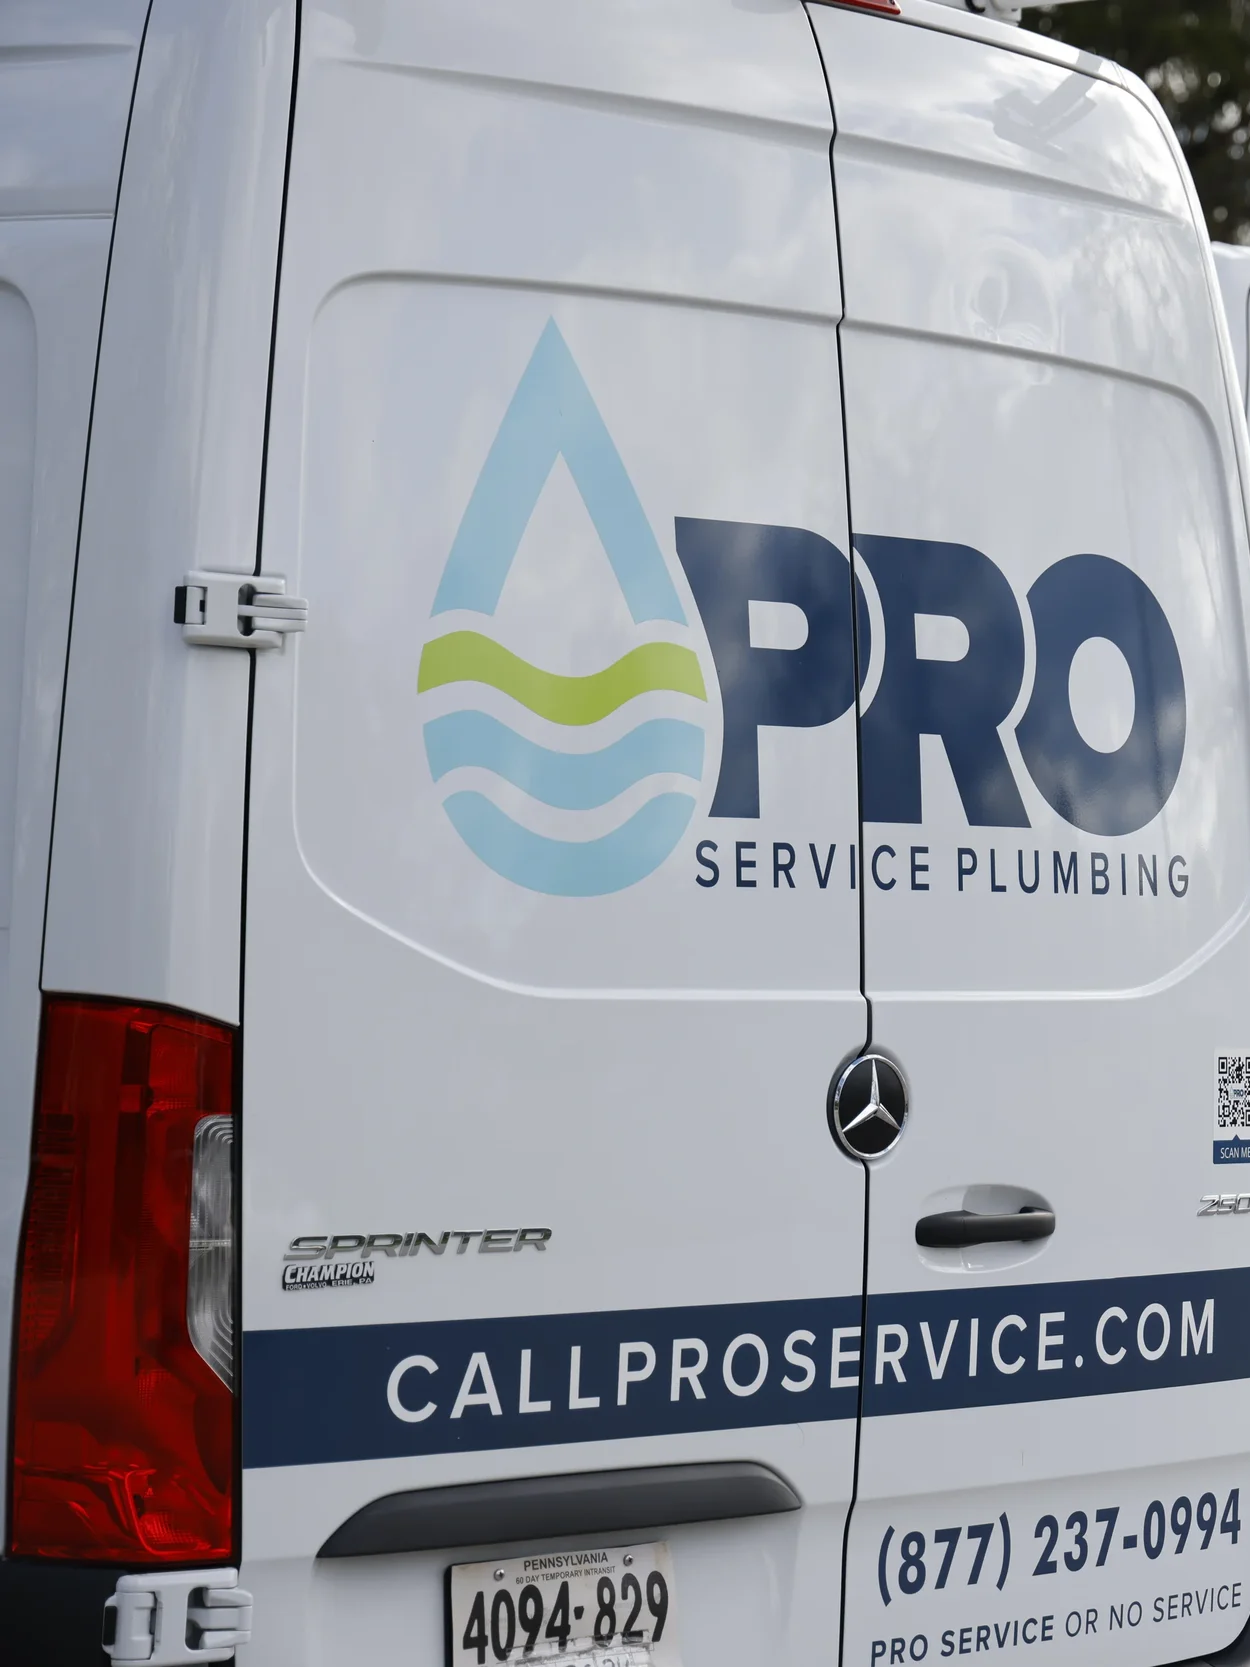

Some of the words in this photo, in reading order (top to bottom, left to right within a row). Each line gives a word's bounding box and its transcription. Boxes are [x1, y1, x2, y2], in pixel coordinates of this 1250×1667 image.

[675, 516, 1187, 837] PRO
[694, 840, 930, 893] SERVICE
[957, 847, 1191, 899] PLUMBING
[1220, 1147, 1239, 1159] SCAN
[283, 1227, 552, 1260] SPRINTER
[284, 1261, 375, 1283] CHAMPION
[387, 1298, 1215, 1423] CALLPROSERVICE.COM
[523, 1551, 608, 1571] PENNSYLVANIA
[878, 1512, 1011, 1608] (877)
[1032, 1487, 1241, 1577] 237-0994
[515, 1577, 524, 1585] 60
[525, 1574, 540, 1584] DAY
[541, 1569, 583, 1582] TEMPORARY
[584, 1566, 616, 1576] INTRANSIT
[871, 1634, 928, 1667] PRO
[940, 1614, 1055, 1658] SERVICE
[1065, 1608, 1098, 1637] OR
[1109, 1600, 1142, 1630] NO
[1153, 1582, 1242, 1624] SERVICE
